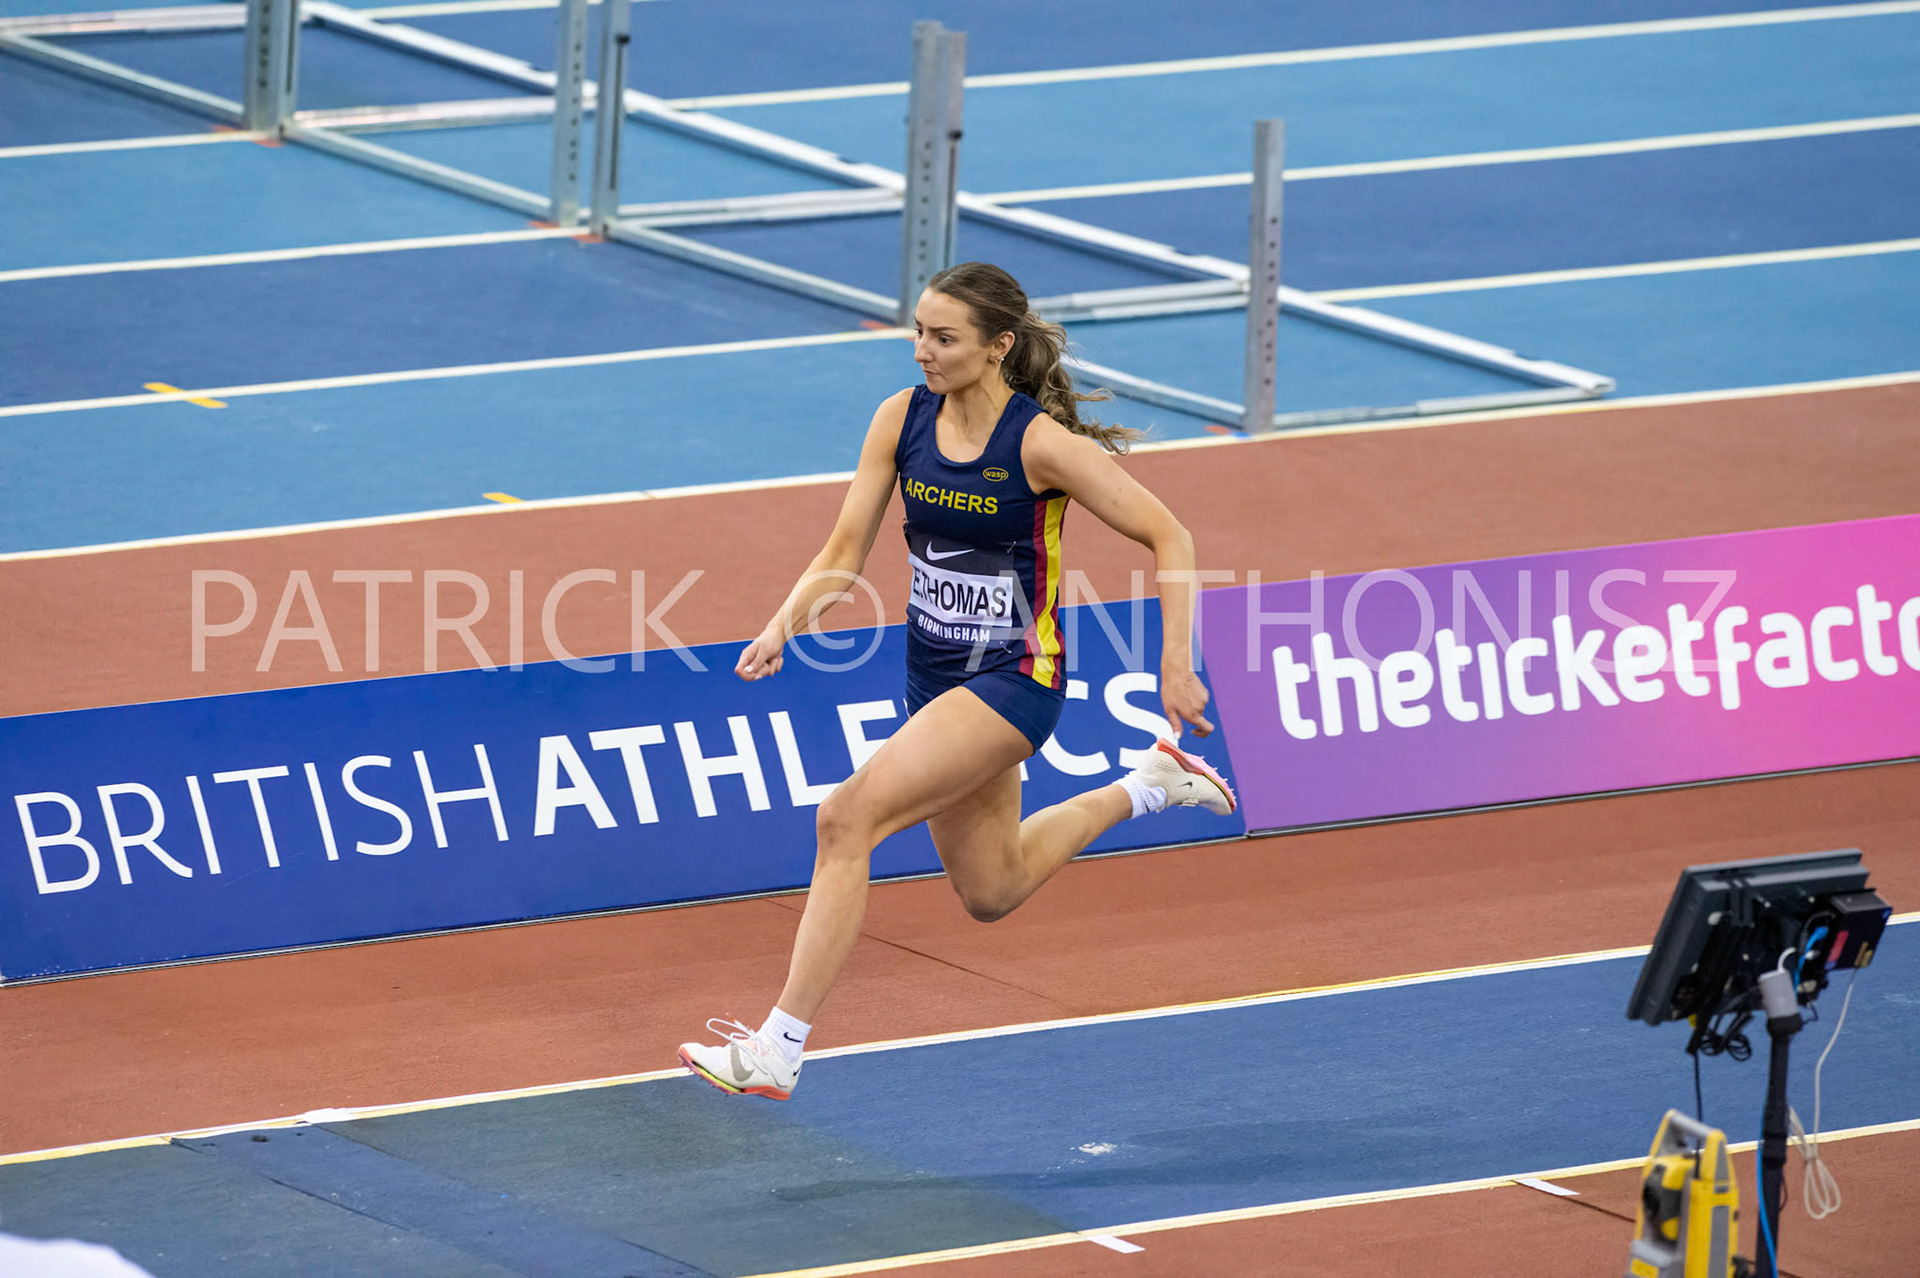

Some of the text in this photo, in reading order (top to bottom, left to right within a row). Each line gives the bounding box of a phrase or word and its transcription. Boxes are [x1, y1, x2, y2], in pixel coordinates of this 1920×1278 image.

[985, 471, 1007, 481] wasp
[905, 478, 998, 515] ARCHERS
[913, 566, 1007, 618] E.THOMAS
[917, 613, 990, 643] BIRMINGHAM
[533, 672, 1179, 836] ATHLECS
